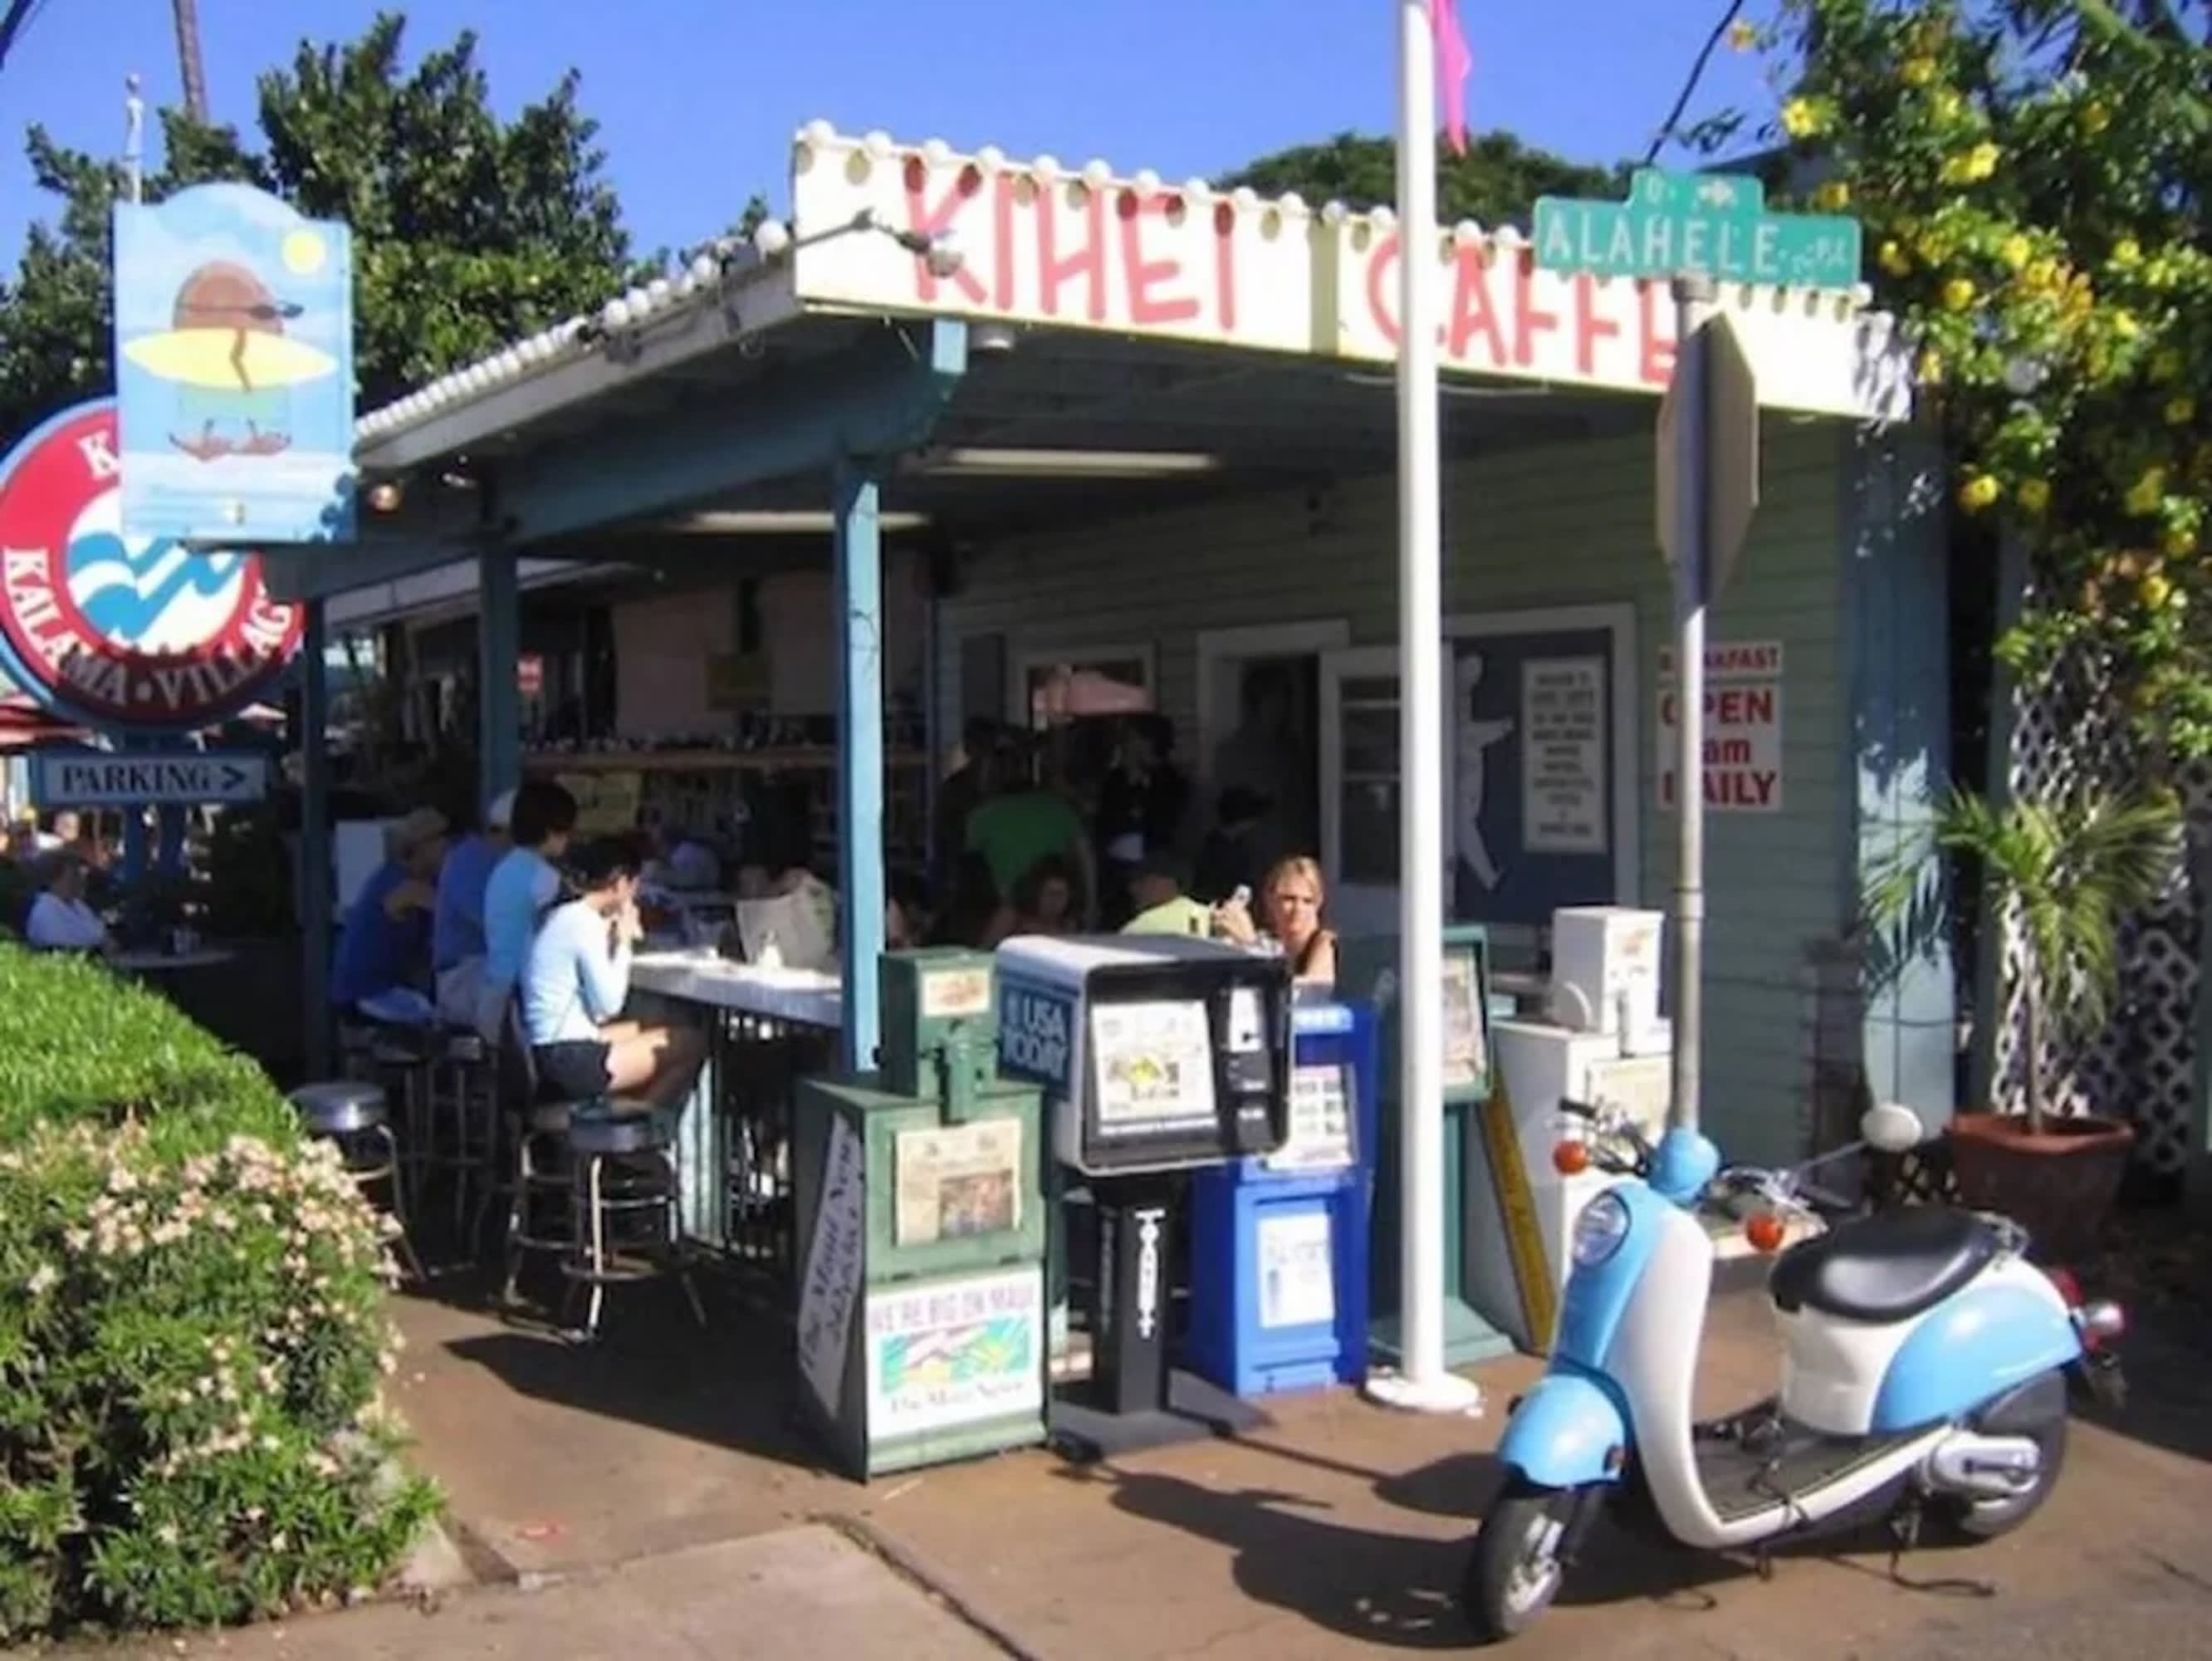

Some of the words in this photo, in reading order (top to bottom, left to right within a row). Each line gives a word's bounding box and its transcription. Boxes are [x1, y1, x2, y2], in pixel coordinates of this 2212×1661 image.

[903, 154, 1235, 331] KIHEI
[1544, 209, 1782, 275] ALAHELE
[3, 544, 130, 705] KALAMA
[158, 580, 294, 711] VILLAG
[61, 762, 210, 796] PARKING
[1663, 772, 1776, 805] AILY
[1023, 996, 1066, 1043] USA
[1002, 1026, 1069, 1079] TODAY
